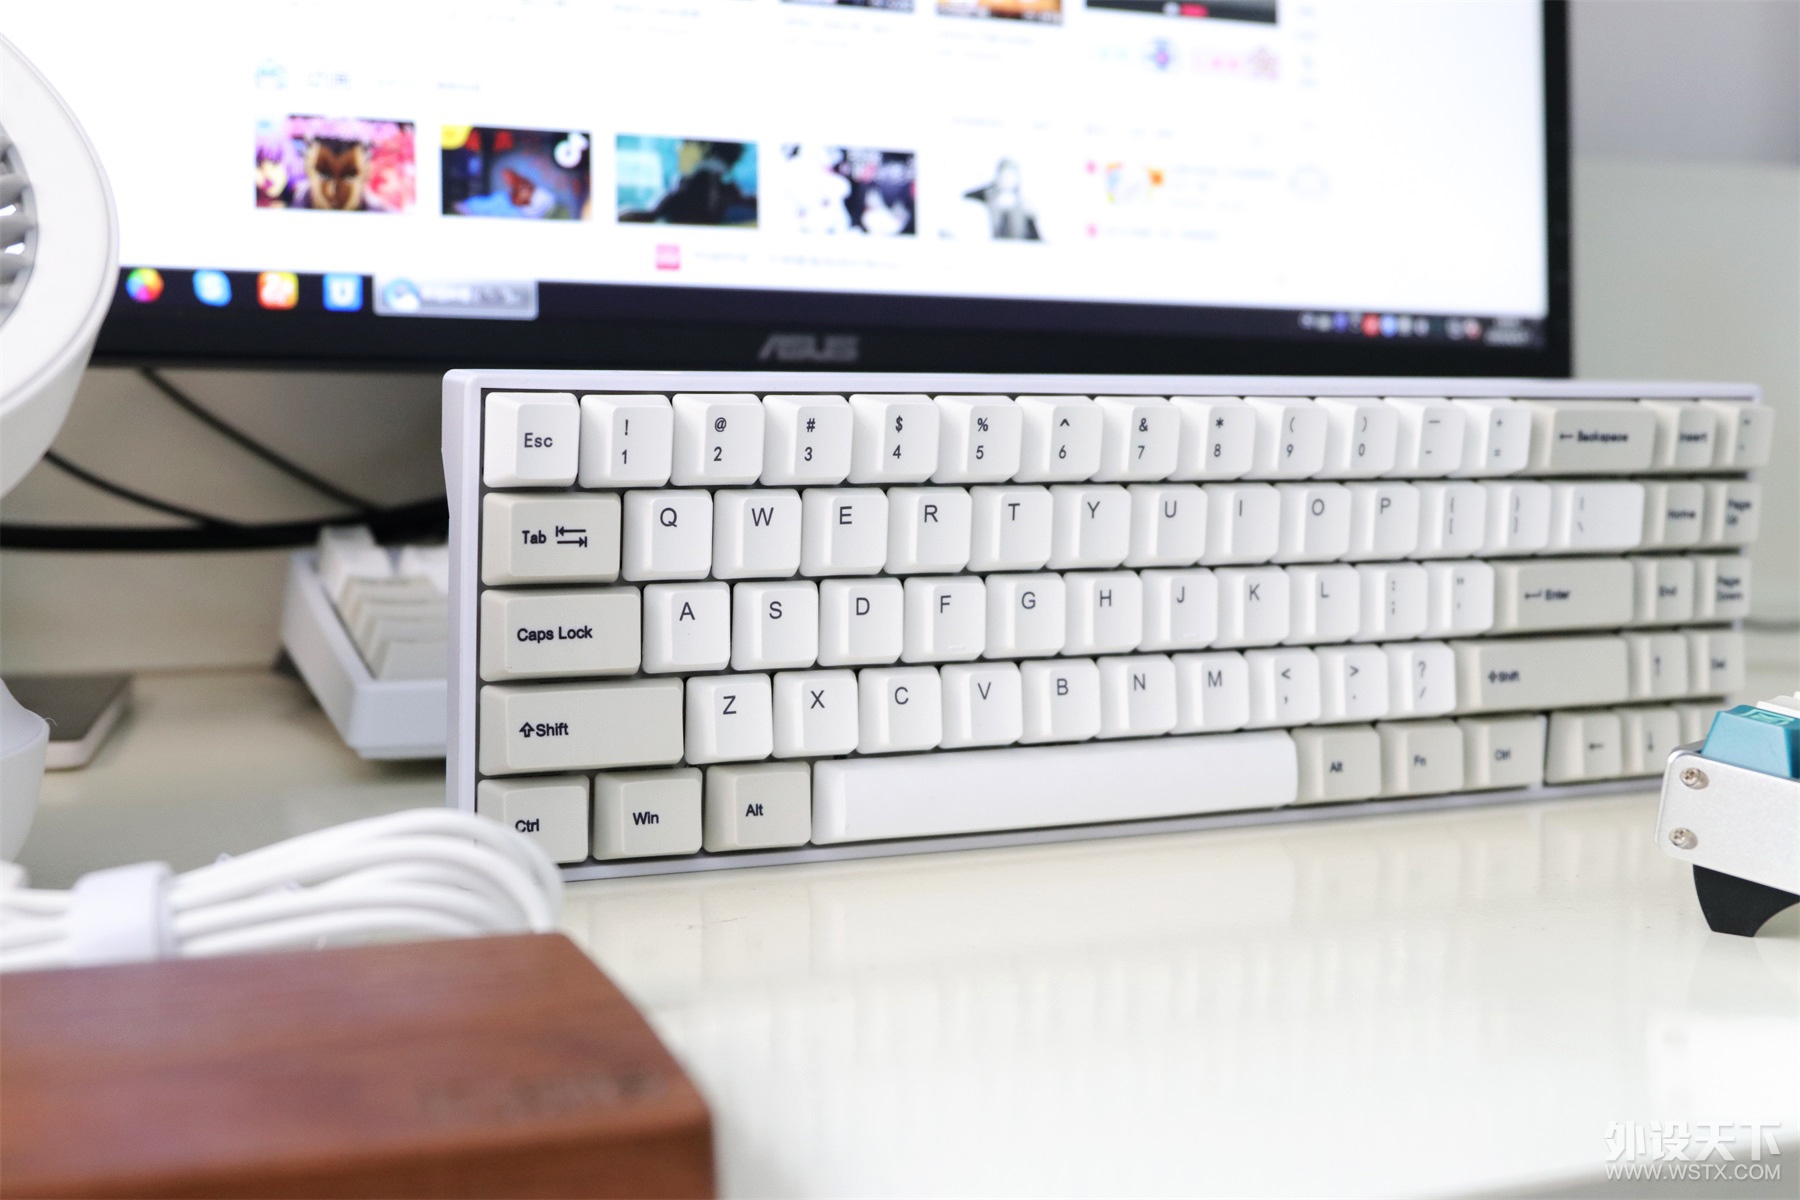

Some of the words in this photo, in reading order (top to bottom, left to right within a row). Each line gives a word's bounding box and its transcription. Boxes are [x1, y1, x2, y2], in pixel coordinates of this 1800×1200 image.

[714, 416, 727, 433] @
[805, 417, 816, 433] #
[894, 414, 904, 434] $
[976, 417, 989, 433] %
[1059, 418, 1071, 427] ^
[1138, 417, 1149, 433] &
[523, 431, 554, 449] Esc
[1576, 429, 1629, 444] Backspace
[621, 448, 628, 465] 1
[713, 445, 723, 462] 2
[803, 446, 813, 462] 3
[892, 444, 902, 460] 4
[975, 444, 985, 461] 5
[1058, 444, 1067, 460] 6
[1137, 444, 1146, 460] 7
[1213, 443, 1222, 458] 8
[1285, 443, 1295, 458] 9
[923, 504, 939, 524] R
[1007, 502, 1021, 522] T
[1086, 500, 1101, 520] Y
[1164, 500, 1178, 519] U
[1310, 497, 1326, 517] O
[1379, 496, 1392, 515] P
[659, 507, 678, 528] Q
[751, 506, 775, 527] W
[839, 505, 853, 526] E
[521, 529, 548, 545] Tab
[1099, 588, 1112, 608] H
[1176, 585, 1186, 604] J
[1248, 583, 1260, 602] K
[1319, 581, 1330, 599] L
[1544, 588, 1571, 602] Enter
[1657, 584, 1679, 599] End
[855, 596, 871, 616] D
[939, 594, 952, 614] F
[1020, 590, 1036, 610] G
[678, 601, 696, 622] A
[768, 600, 783, 620] S
[516, 626, 555, 644] Caps
[558, 624, 594, 641] Lock
[1280, 668, 1291, 680] <
[1349, 665, 1360, 678] >
[1417, 659, 1428, 679] ?
[1497, 670, 1520, 683] Shift
[1056, 677, 1070, 697] B
[1133, 673, 1146, 691] N
[1207, 669, 1223, 688] M
[810, 689, 826, 710] X
[894, 686, 909, 706] C
[977, 681, 992, 701] V
[722, 694, 737, 716] Z
[535, 721, 570, 738] Shift
[1413, 754, 1427, 767] Fn
[1494, 748, 1512, 762] Ctrl
[1329, 761, 1344, 774] Alt
[632, 811, 660, 826] Win
[745, 803, 764, 818] Alt
[514, 817, 540, 833] Ctrl
